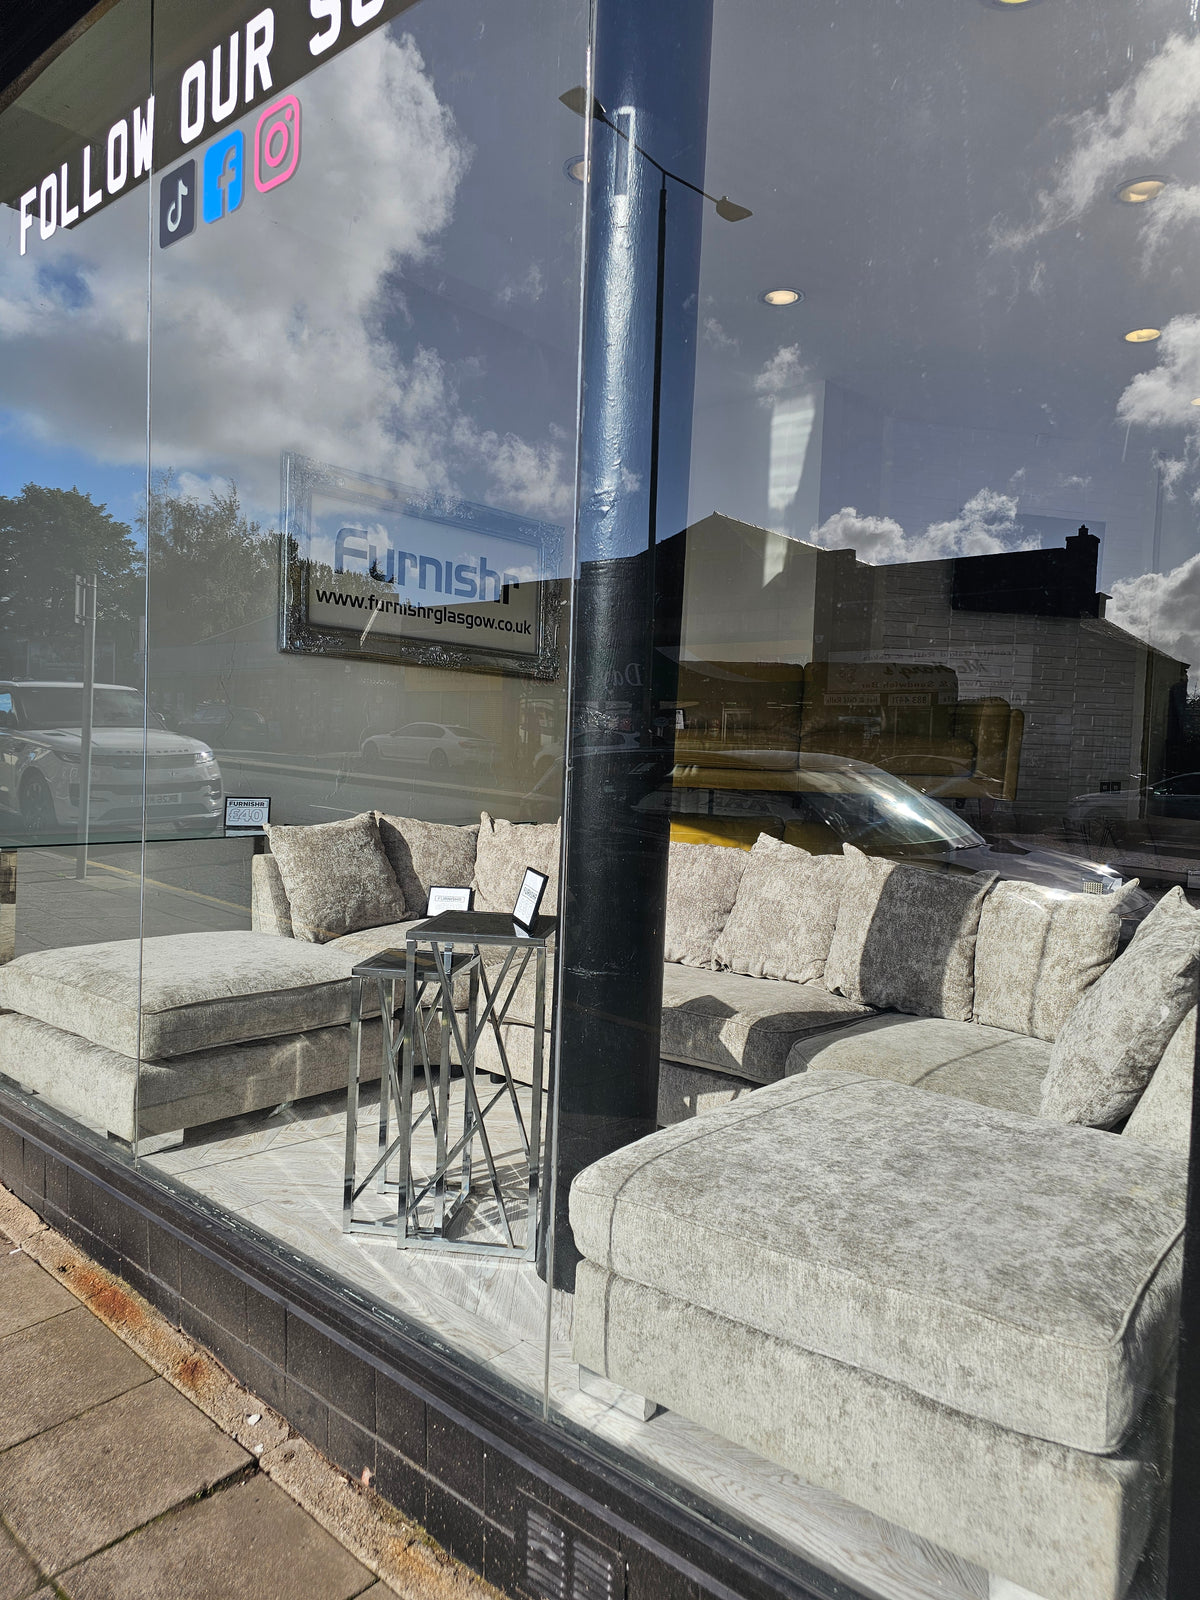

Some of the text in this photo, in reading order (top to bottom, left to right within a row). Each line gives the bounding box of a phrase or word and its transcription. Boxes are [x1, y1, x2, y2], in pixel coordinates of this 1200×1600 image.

[20, 95, 155, 256] FOLLOW
[180, 8, 274, 144] OUR
[334, 527, 520, 605] Furnishr
[315, 589, 532, 635] www.furnishrglasgow.co.uk
[228, 808, 264, 822] £40
